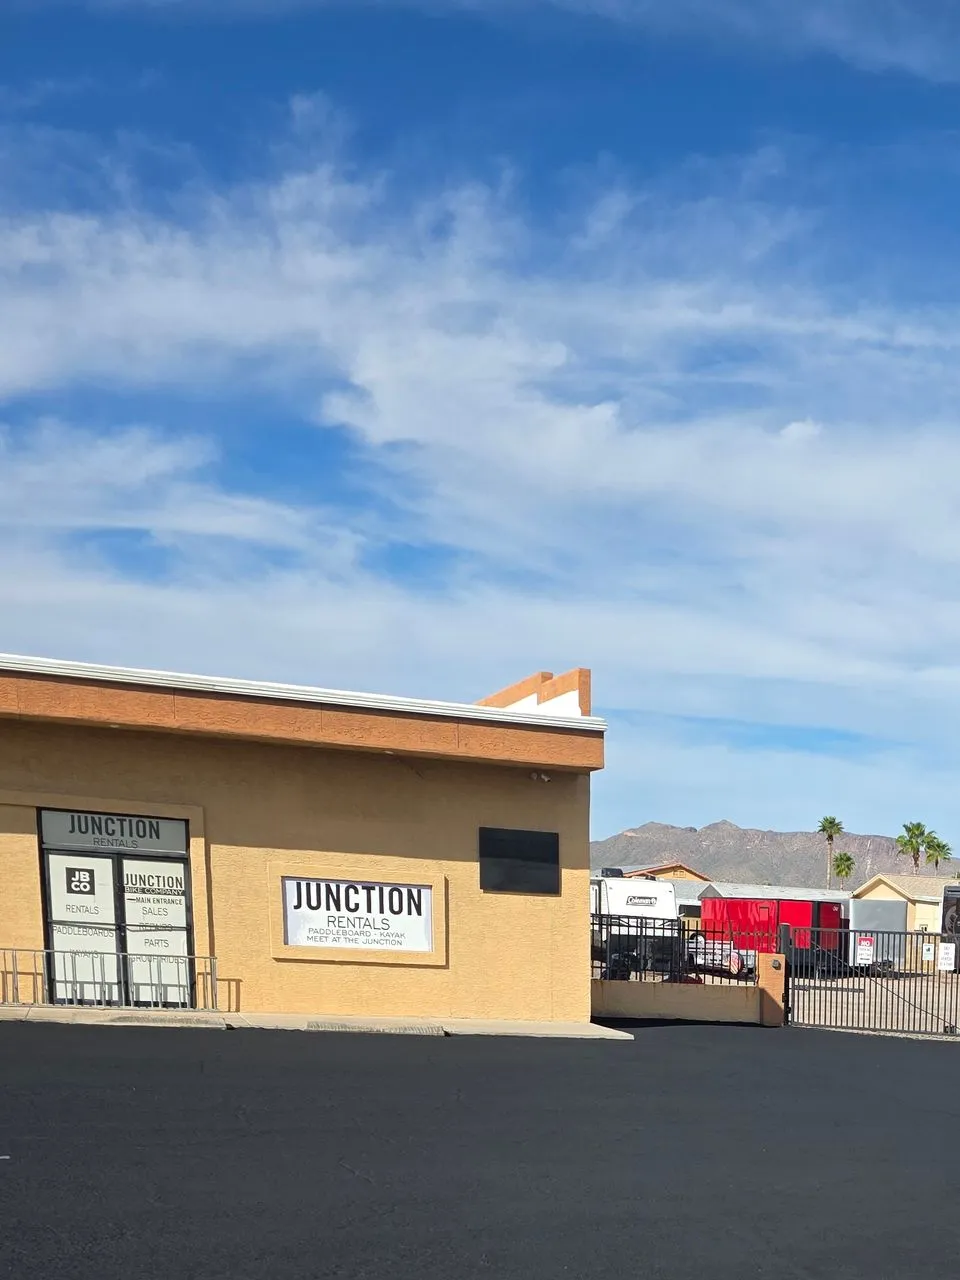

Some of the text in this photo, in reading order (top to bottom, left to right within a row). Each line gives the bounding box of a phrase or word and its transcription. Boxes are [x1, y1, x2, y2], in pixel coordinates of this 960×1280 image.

[69, 814, 160, 840] JUNCTION
[93, 837, 139, 849] RENTALS
[71, 870, 90, 882] JB
[125, 873, 183, 889] JUNCTION
[71, 882, 91, 892] CO
[125, 886, 183, 896] BIKE COMPANY
[152, 898, 183, 906] ENTRANCE
[293, 881, 423, 917] JUNCTION
[65, 904, 100, 915] RENTALS
[142, 906, 168, 917] SALES
[327, 915, 391, 931] RENTALS
[53, 925, 114, 938] PADDLEBOARDS
[308, 927, 372, 938] PADDLEBOARD
[379, 931, 406, 939] KAYAK
[144, 938, 170, 948] PARTS
[306, 935, 329, 943] MEET
[331, 936, 341, 944] AT
[362, 938, 403, 946] JUNCTION
